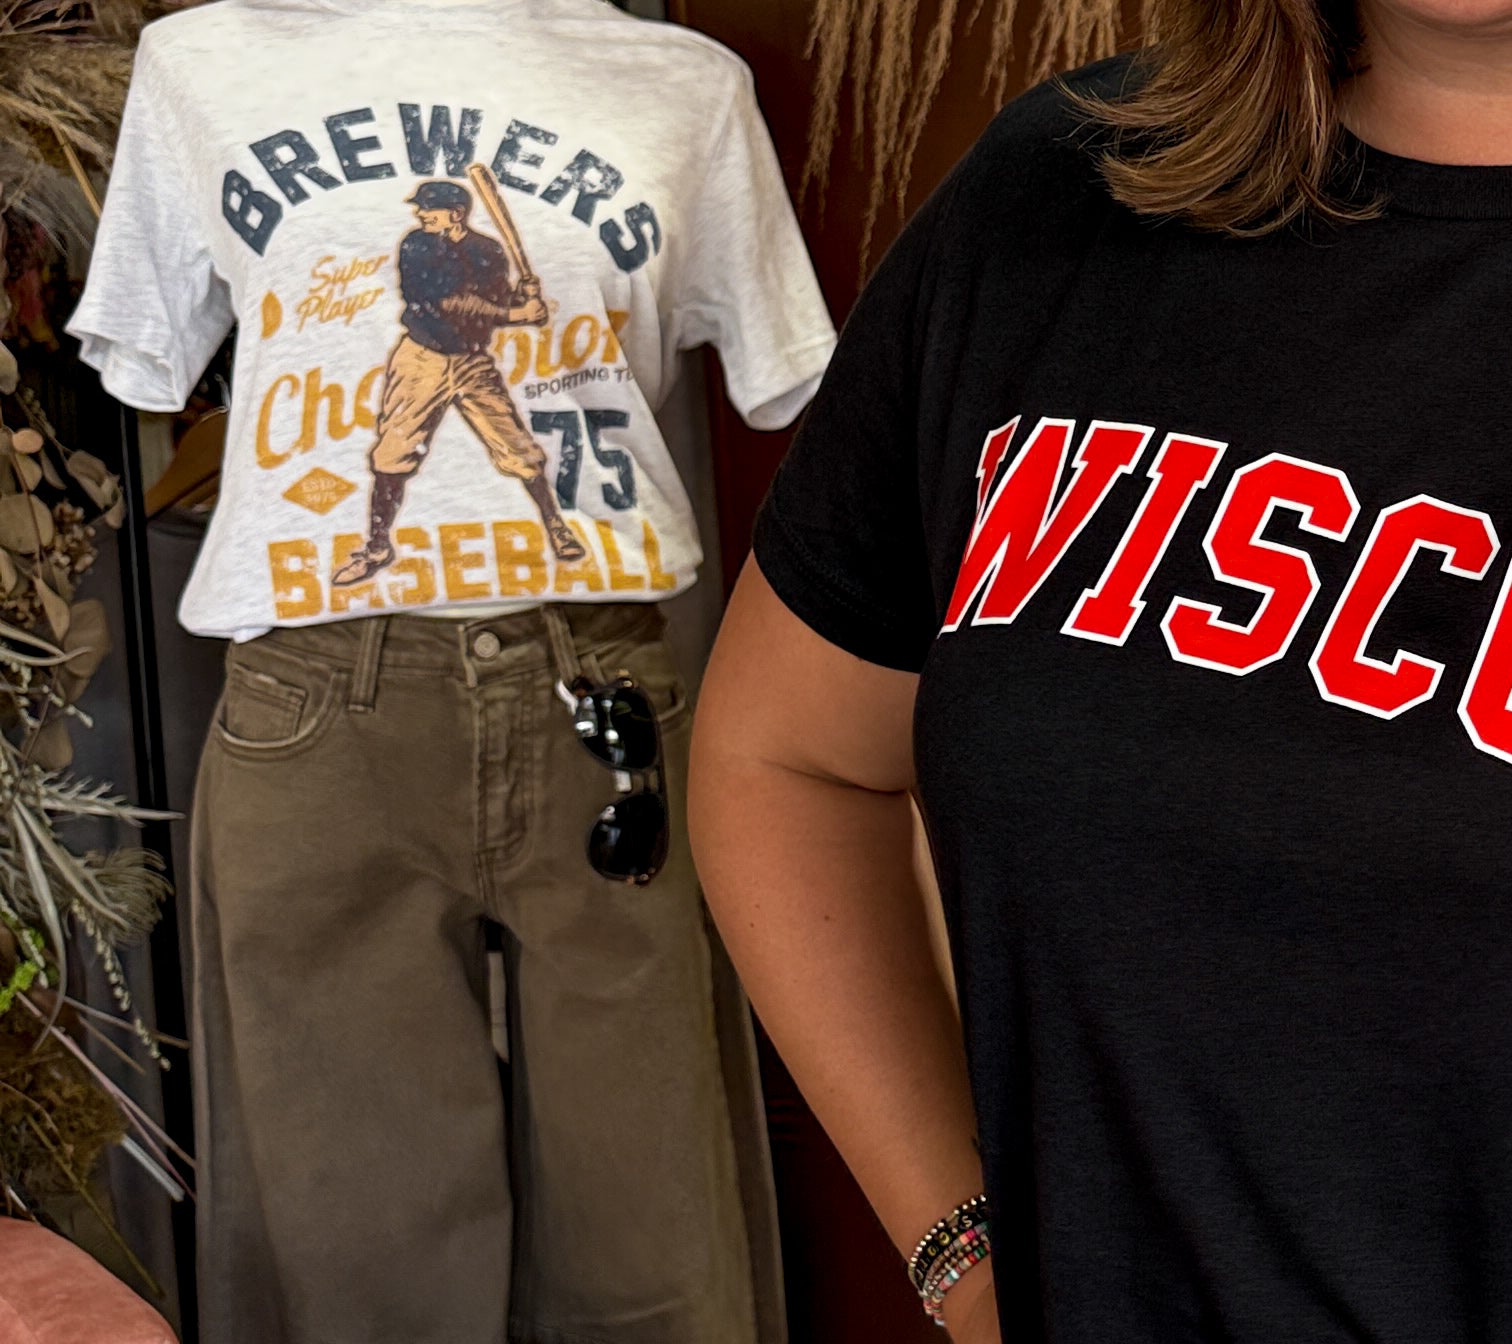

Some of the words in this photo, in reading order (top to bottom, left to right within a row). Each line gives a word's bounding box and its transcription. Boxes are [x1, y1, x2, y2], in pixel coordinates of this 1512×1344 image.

[221, 102, 662, 273] BREWERS
[295, 286, 386, 334] Player
[308, 254, 390, 296] Super
[523, 367, 610, 401] SPORTING
[529, 408, 638, 514] 75
[267, 519, 678, 620] BASEBALL
